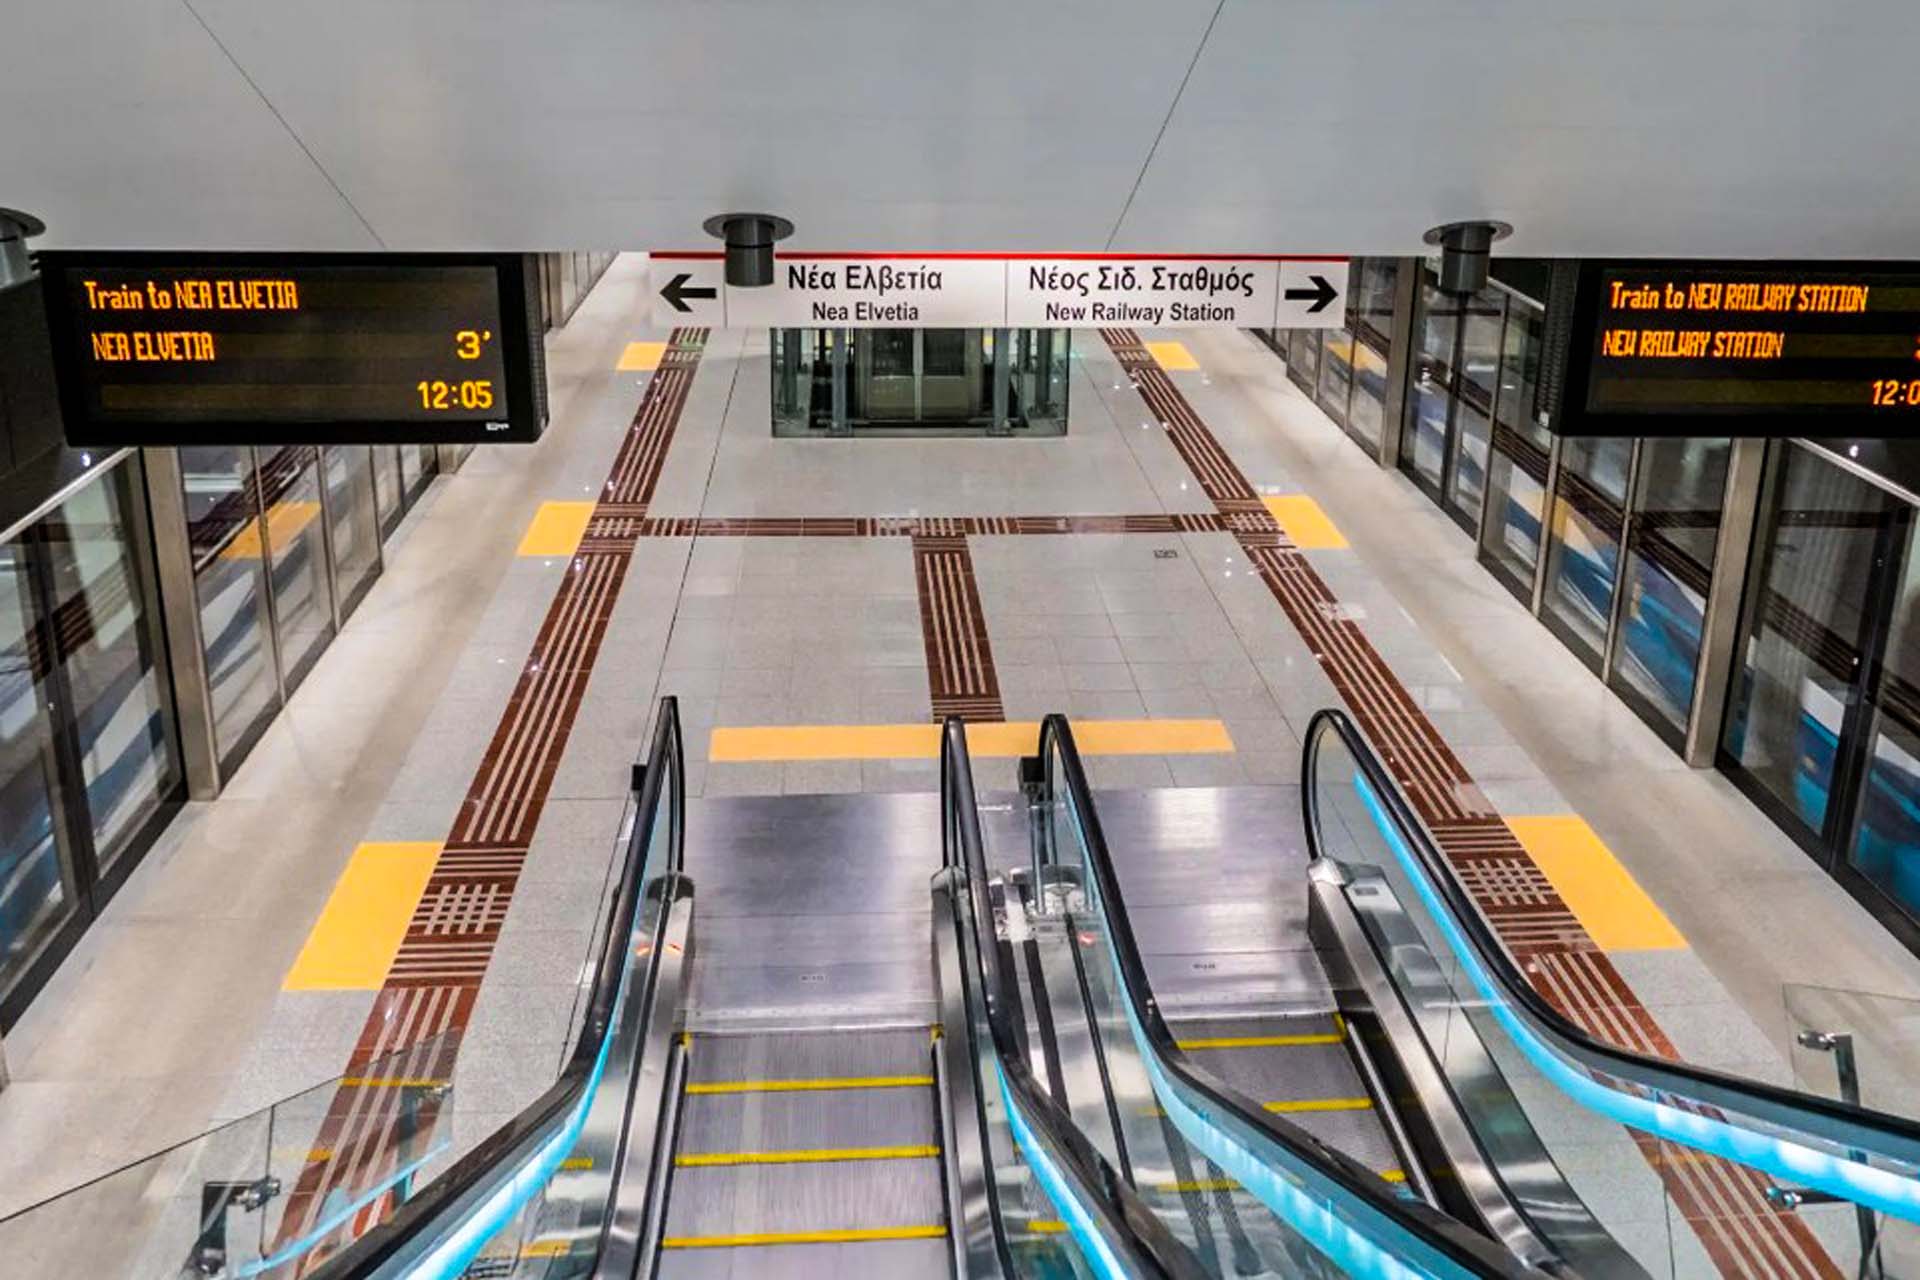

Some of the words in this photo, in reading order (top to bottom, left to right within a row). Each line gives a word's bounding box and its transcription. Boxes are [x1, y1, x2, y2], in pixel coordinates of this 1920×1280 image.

[84, 280, 144, 310] Train
[147, 281, 172, 309] to
[174, 280, 214, 310] NEA
[215, 280, 299, 310] ELVETIA
[788, 263, 836, 290] Νέα
[846, 264, 943, 297] Ελβετία
[1030, 265, 1089, 297] Νέος
[1098, 266, 1142, 291] Σιδ.
[1151, 265, 1255, 298] Σταθμός
[812, 301, 849, 321] Nea
[855, 301, 919, 321] Elvetia
[1611, 281, 1661, 310] Train
[1663, 282, 1686, 310] to
[1687, 282, 1723, 311] NEW
[1724, 283, 1797, 312] RAILWAY
[1797, 284, 1869, 313] STATION
[1046, 303, 1086, 321] New
[1092, 302, 1164, 325] Railway
[1170, 302, 1235, 321] Station
[92, 331, 132, 361] NEA
[133, 331, 215, 361] ELVETIA
[1602, 329, 1638, 358] NEW
[1638, 329, 1711, 358] RAILWAY
[1711, 331, 1785, 359] STATION
[416, 380, 494, 411] 12:05
